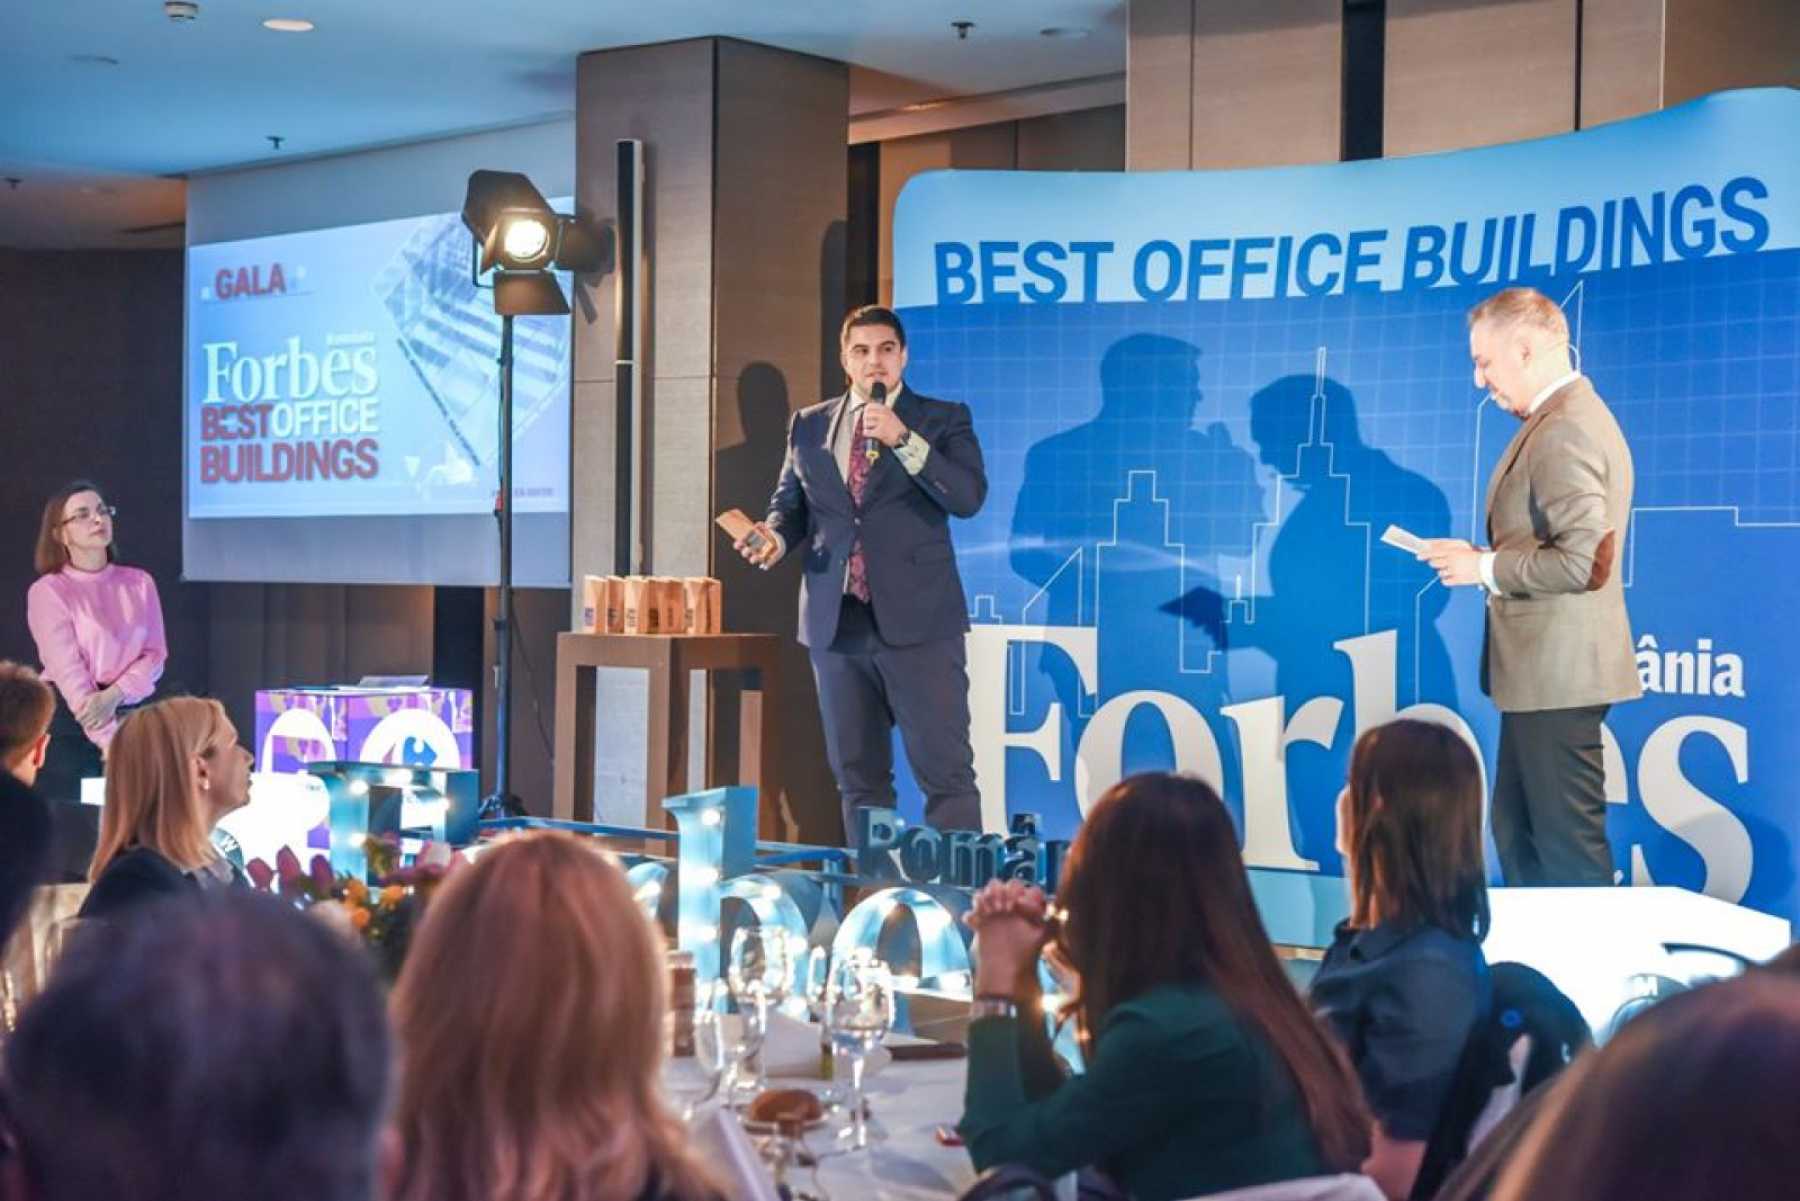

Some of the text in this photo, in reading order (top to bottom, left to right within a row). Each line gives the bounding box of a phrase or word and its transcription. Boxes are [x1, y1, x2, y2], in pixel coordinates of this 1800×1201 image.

[934, 176, 1770, 304] BEST OFFICE BUILDINGS
[214, 262, 287, 300] GALA
[203, 335, 378, 404] Forbes
[200, 438, 379, 484] BUILDINGS
[1635, 634, 1746, 697] ânia
[963, 624, 1754, 906] Fors
